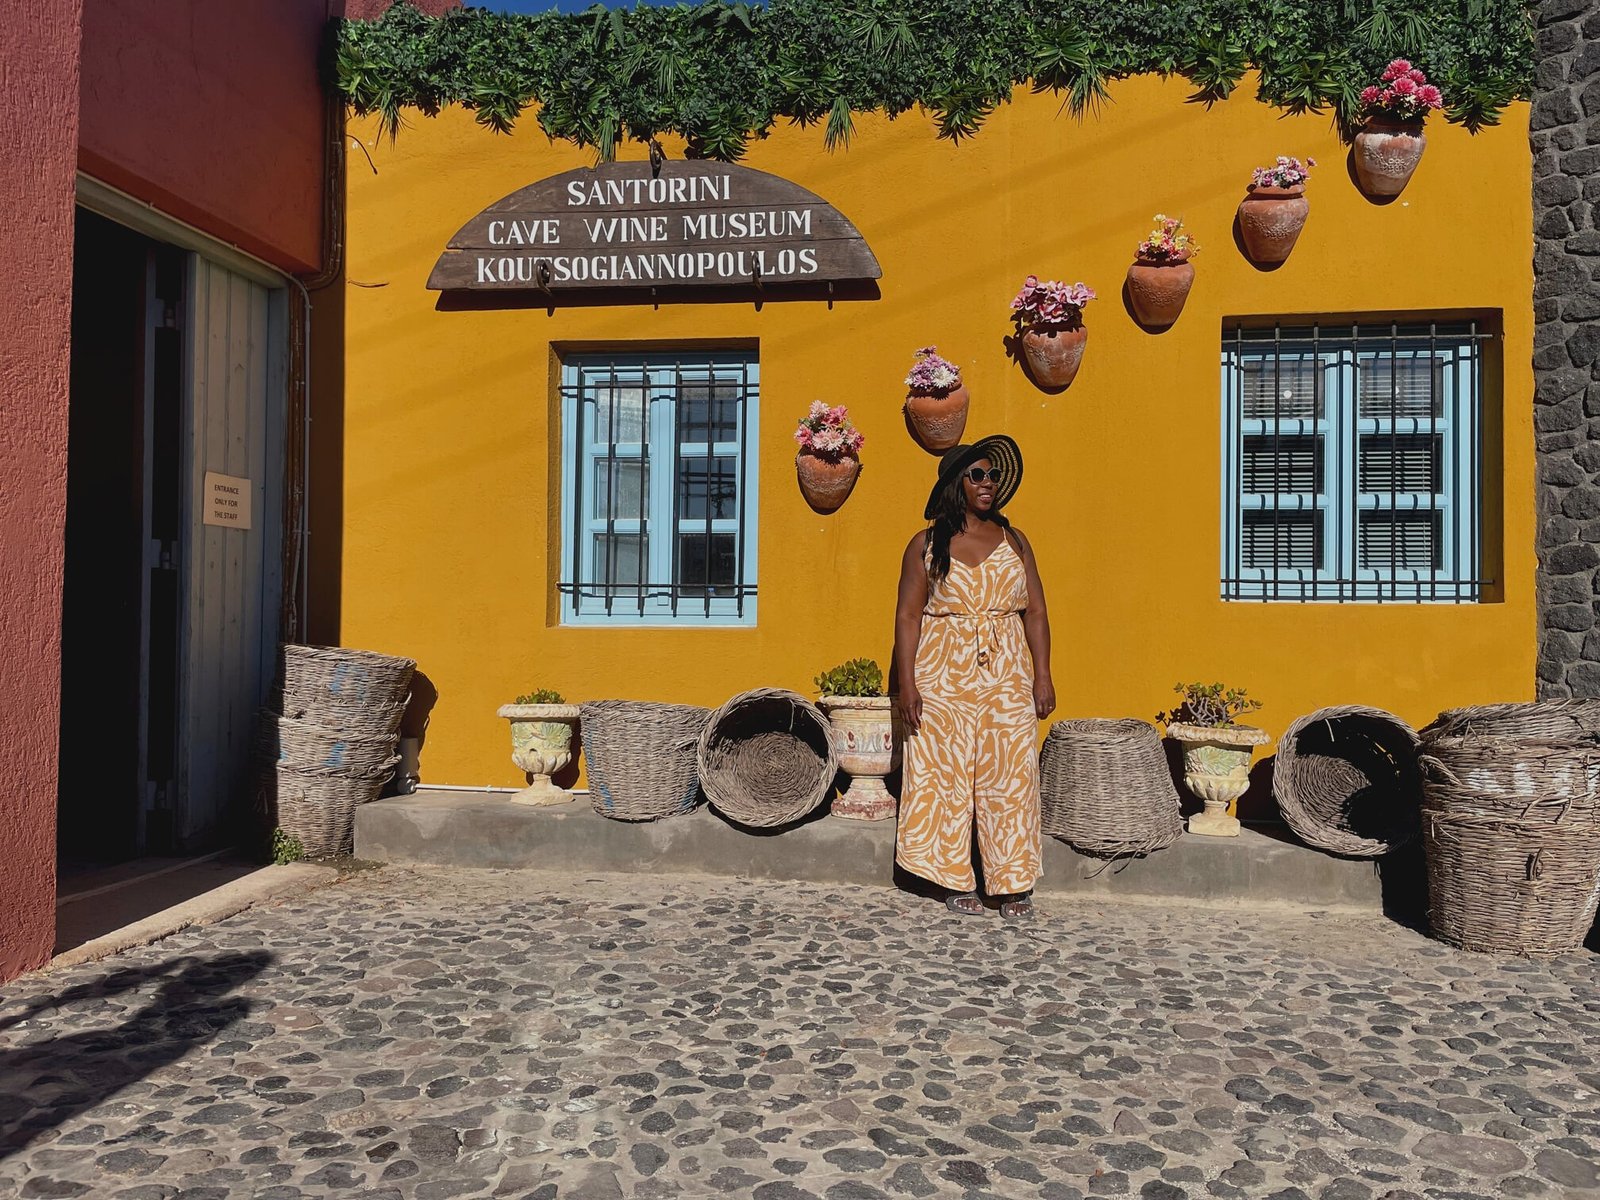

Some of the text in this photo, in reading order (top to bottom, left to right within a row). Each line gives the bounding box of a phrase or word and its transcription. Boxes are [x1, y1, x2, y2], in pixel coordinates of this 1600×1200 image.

[567, 175, 731, 206] SANTORINI
[488, 209, 811, 245] CAVE WINE MUSEUM
[214, 484, 239, 495] ENTRANCE
[214, 498, 227, 506] ONLY
[214, 511, 238, 520] THE STAFF
